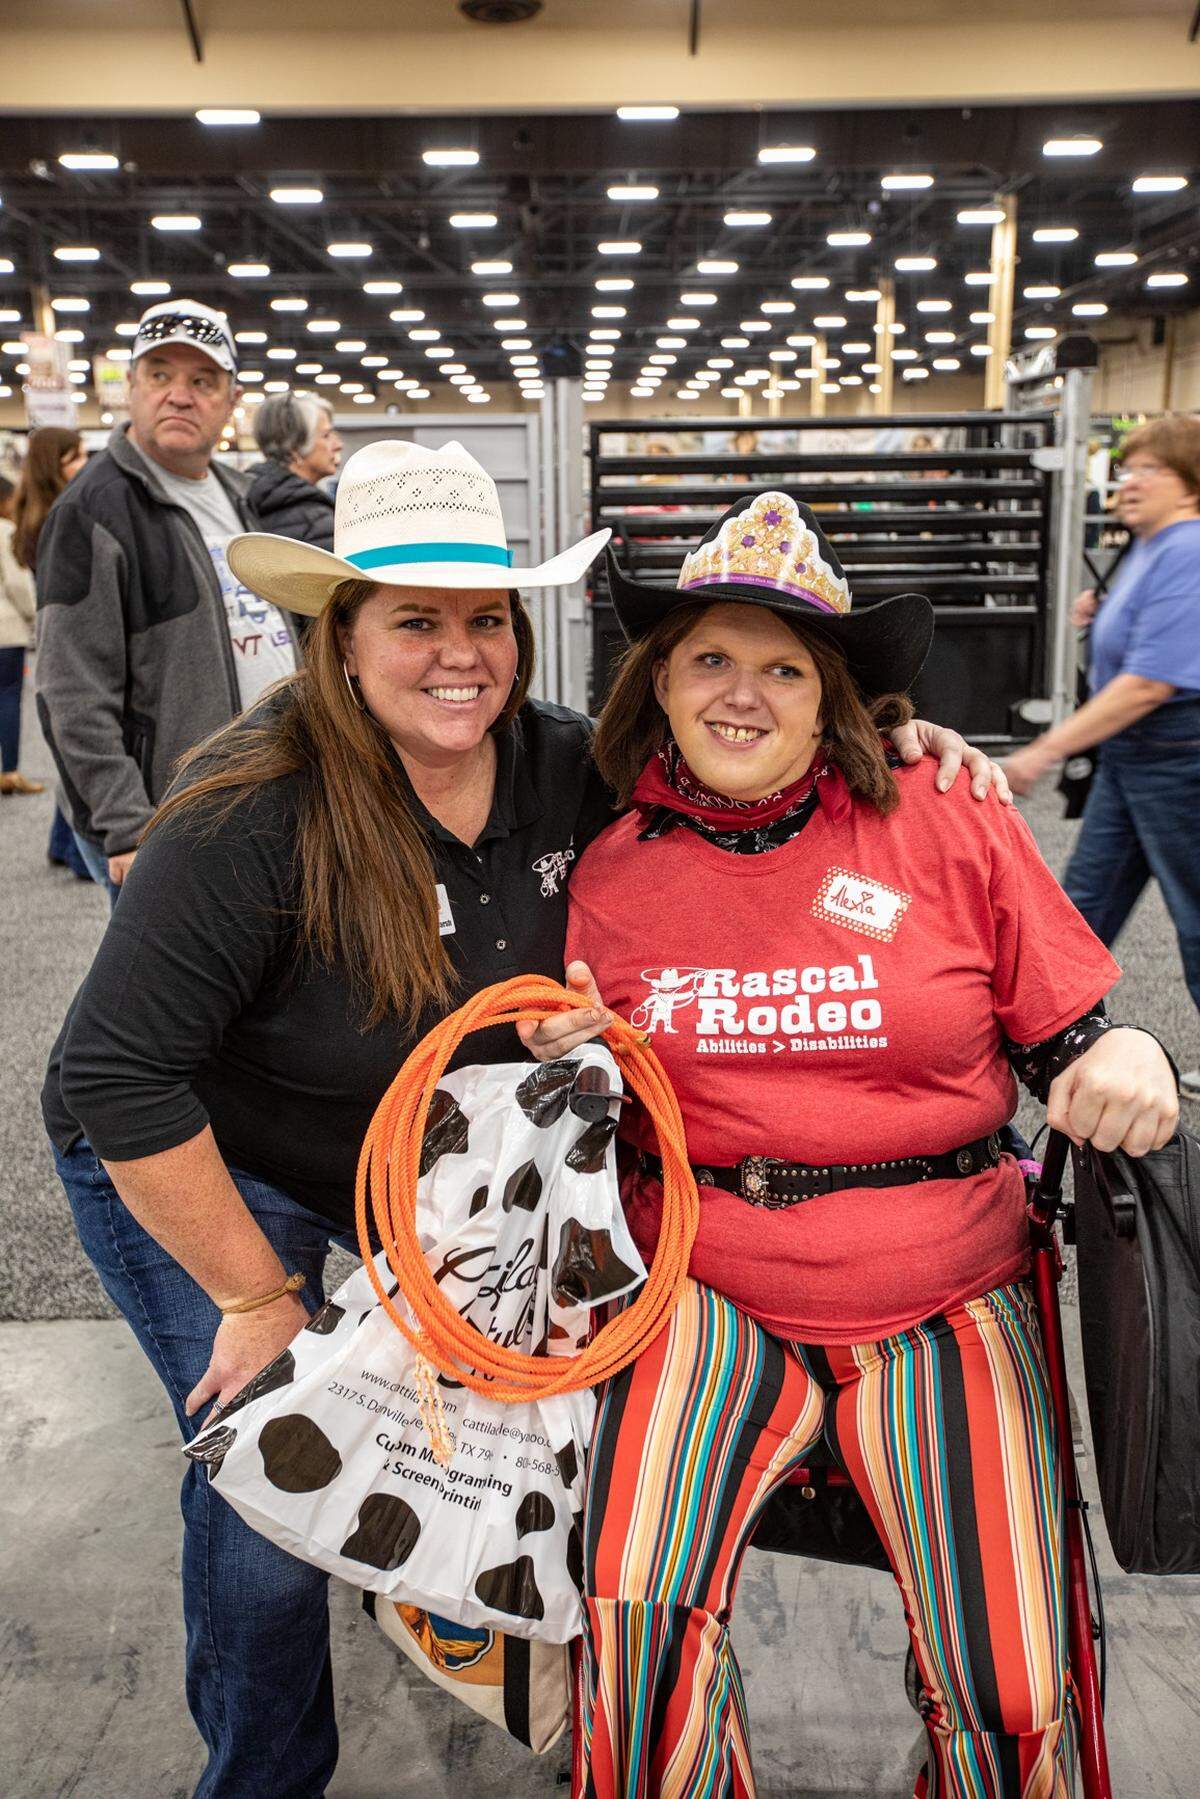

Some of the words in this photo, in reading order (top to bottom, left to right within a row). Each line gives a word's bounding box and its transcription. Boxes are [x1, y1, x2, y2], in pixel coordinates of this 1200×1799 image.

[232, 635, 262, 656] VT
[829, 884, 877, 917] Alexia
[697, 953, 879, 998] Rascal
[695, 993, 883, 1036] Rodeo
[695, 1037, 767, 1054] Abilities
[789, 1035, 889, 1053] Disabilities
[327, 1381, 358, 1401] 2317
[356, 1394, 366, 1407] S.
[366, 1398, 410, 1428] Danville
[459, 1441, 476, 1457] TX
[391, 1461, 441, 1490] Screen
